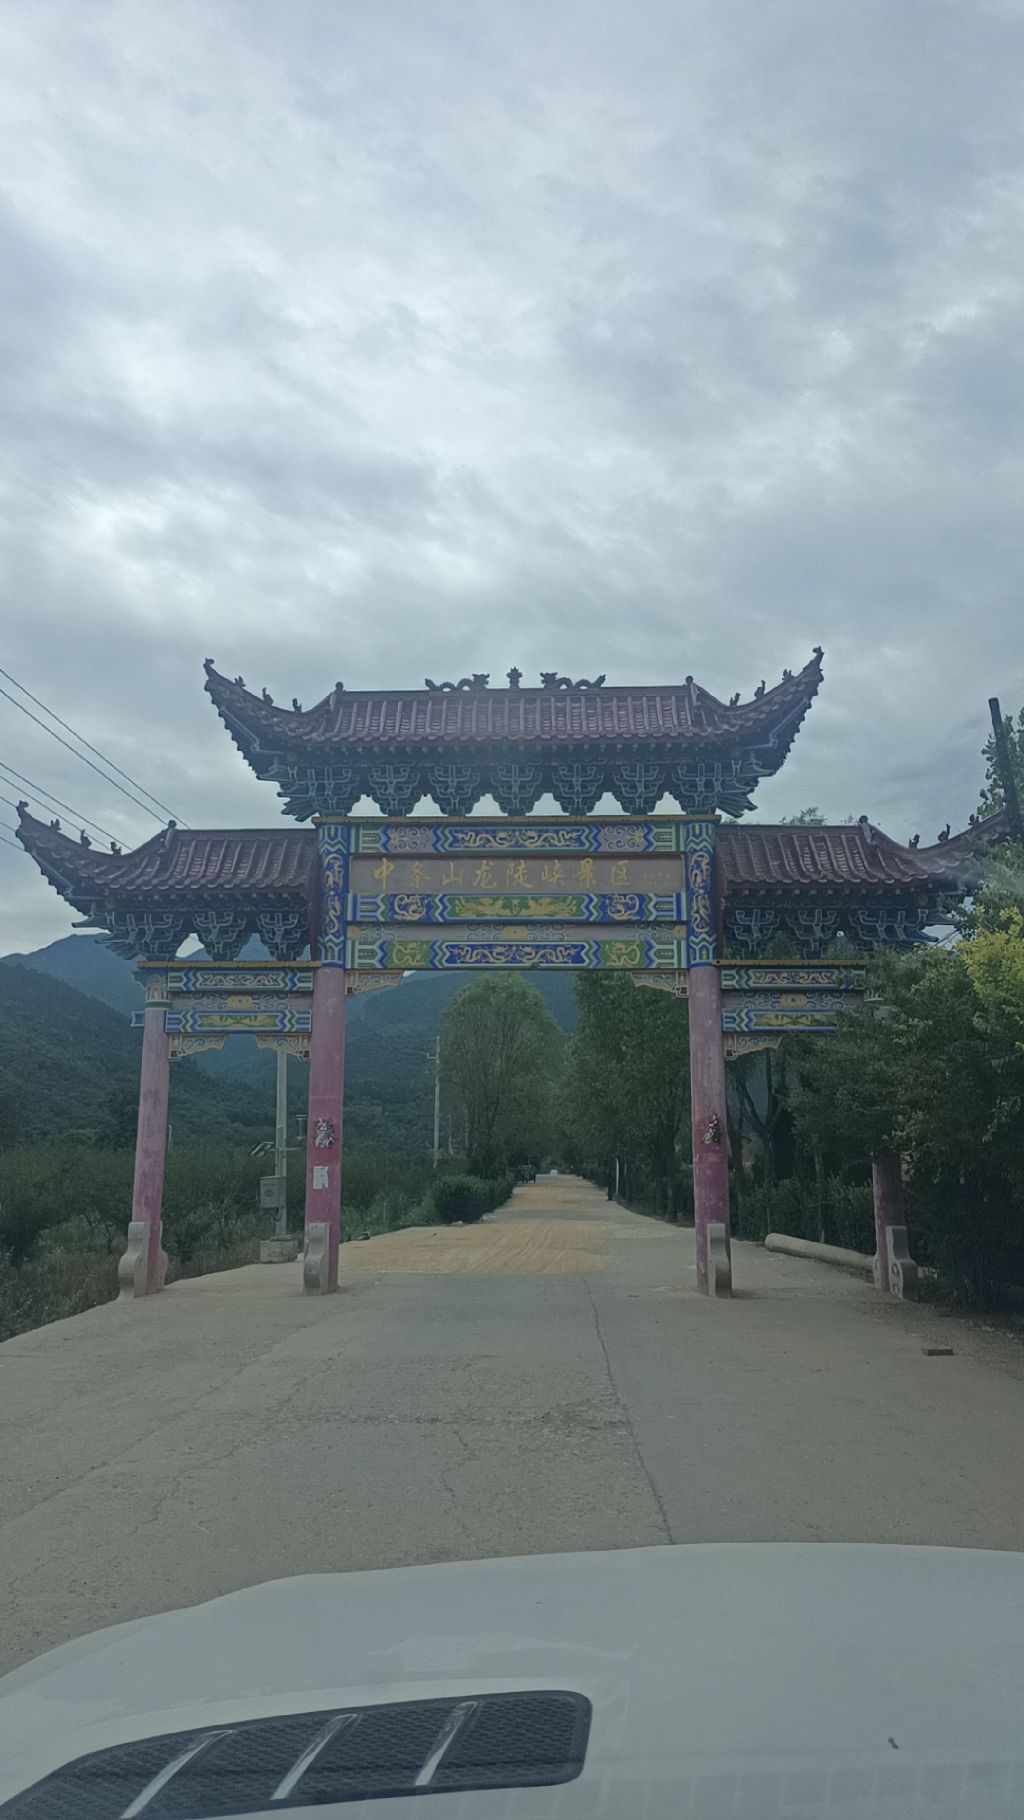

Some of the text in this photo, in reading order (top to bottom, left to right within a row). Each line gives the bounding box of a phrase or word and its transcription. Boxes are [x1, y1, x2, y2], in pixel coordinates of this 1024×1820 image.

[373, 857, 631, 891] 中条山龙陡峡景区
